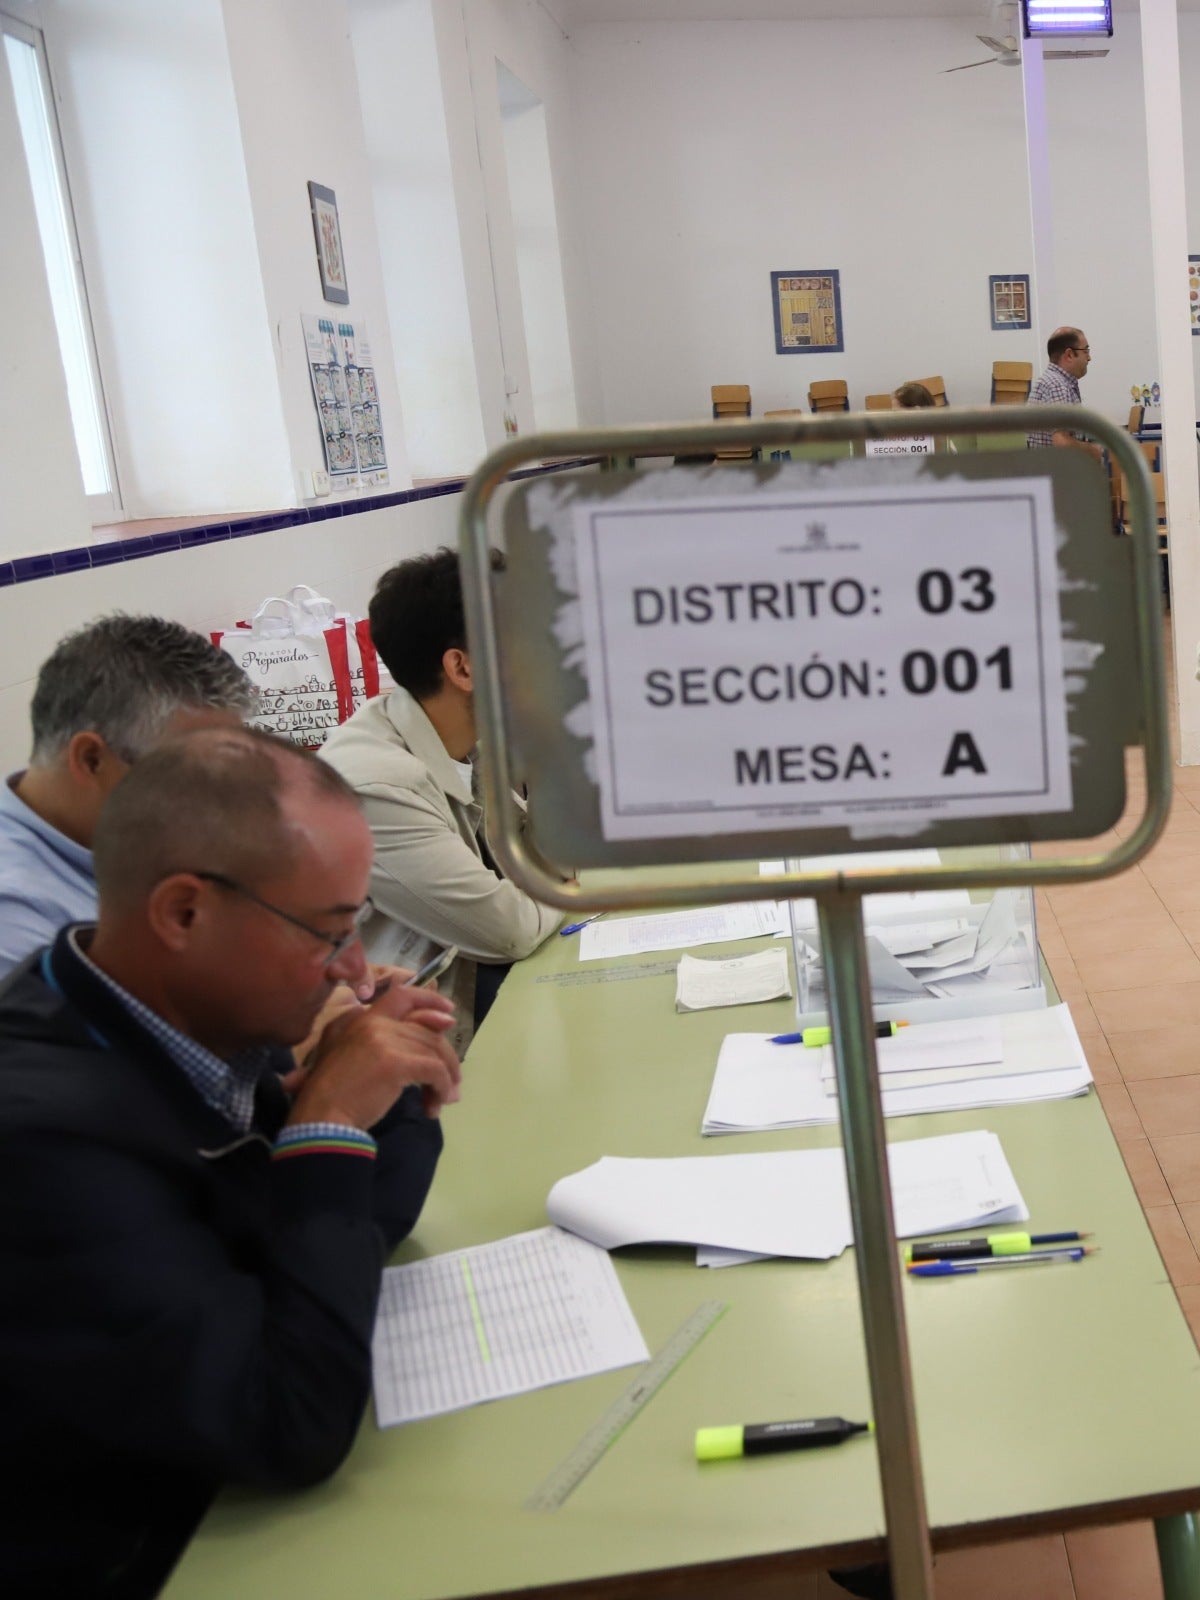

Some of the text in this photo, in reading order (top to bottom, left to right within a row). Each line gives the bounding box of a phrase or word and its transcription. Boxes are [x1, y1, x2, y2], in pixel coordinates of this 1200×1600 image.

[910, 445, 928, 453] 001
[632, 566, 996, 626] DISTRITO: 03
[242, 647, 313, 675] Preparados
[258, 648, 292, 657] PLATOS
[645, 645, 1014, 707] SECCIÓN: 001
[734, 731, 988, 785] MESA: A
